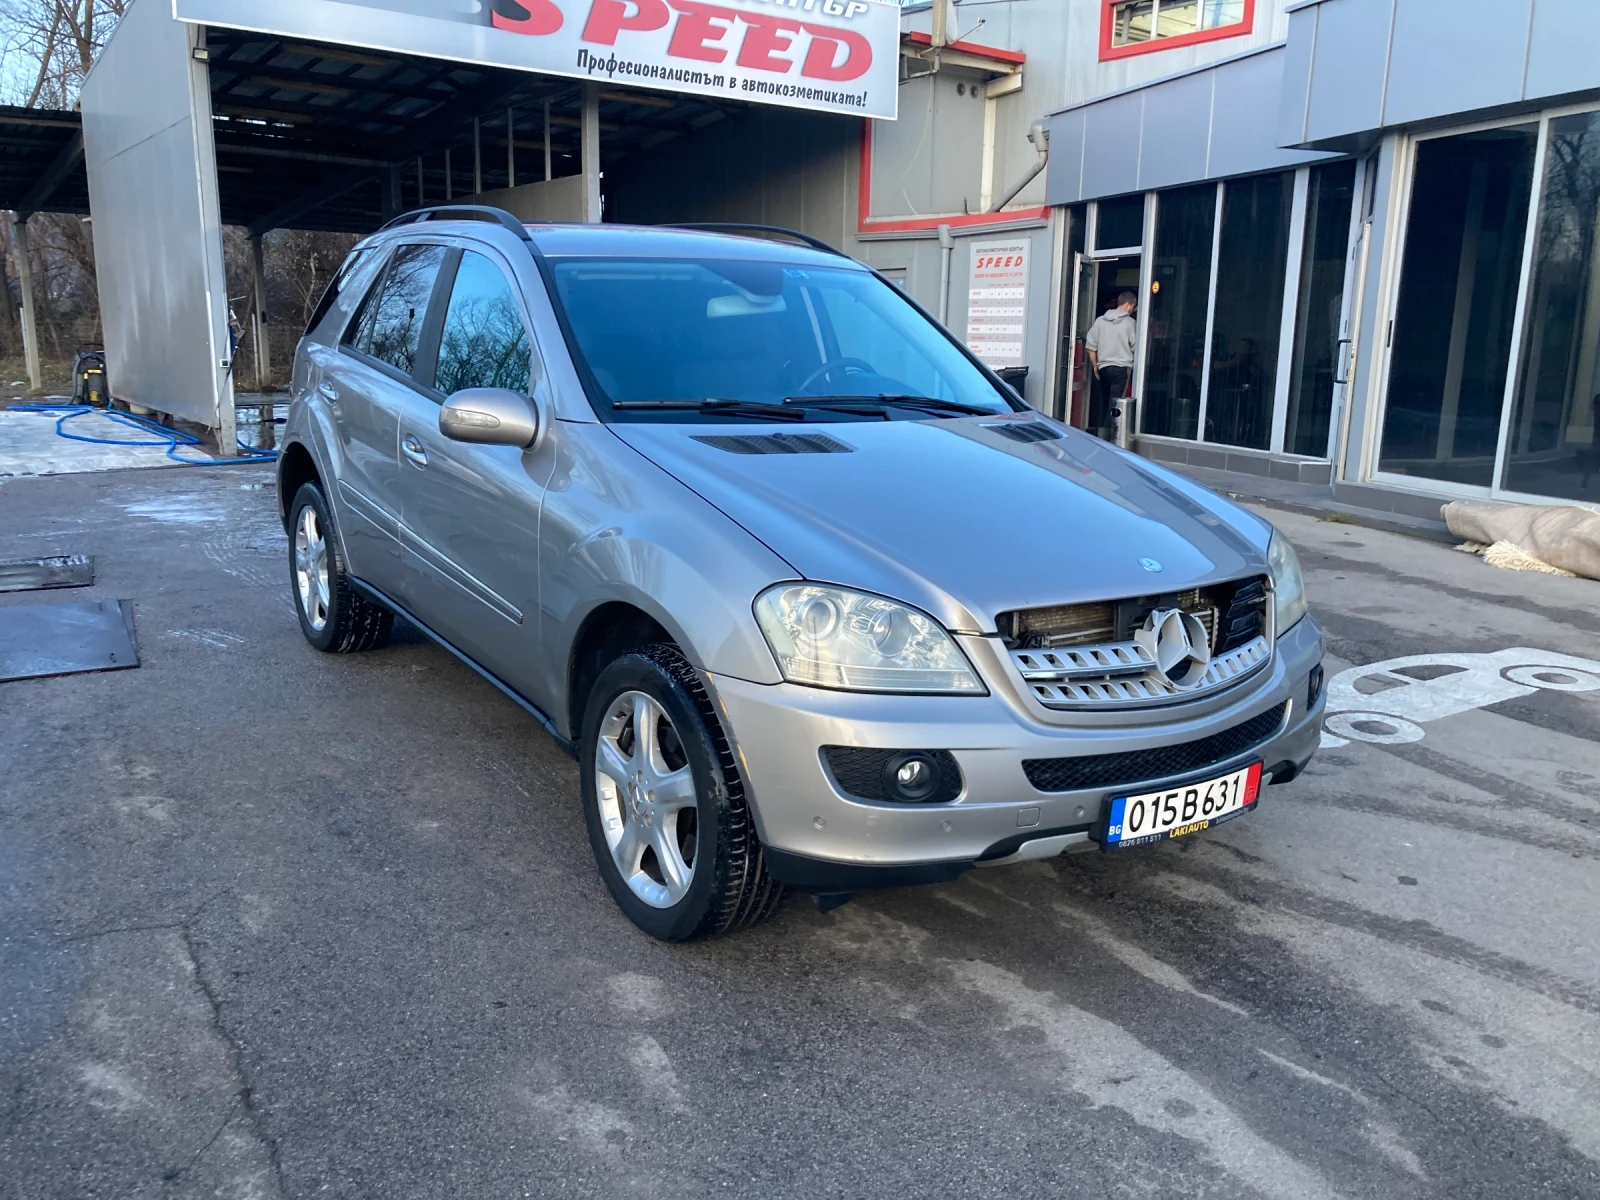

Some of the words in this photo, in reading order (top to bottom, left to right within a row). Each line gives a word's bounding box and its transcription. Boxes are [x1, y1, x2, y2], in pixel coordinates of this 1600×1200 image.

[491, 0, 873, 82] SPEED
[576, 49, 725, 89] Професионалистът
[729, 76, 737, 89] в
[741, 79, 868, 108] автокозметиката!
[976, 255, 1023, 269] SPEED
[1129, 775, 1241, 833] 015B631
[1108, 824, 1122, 836] BG
[1136, 836, 1149, 845] 911
[1149, 834, 1162, 843] 511
